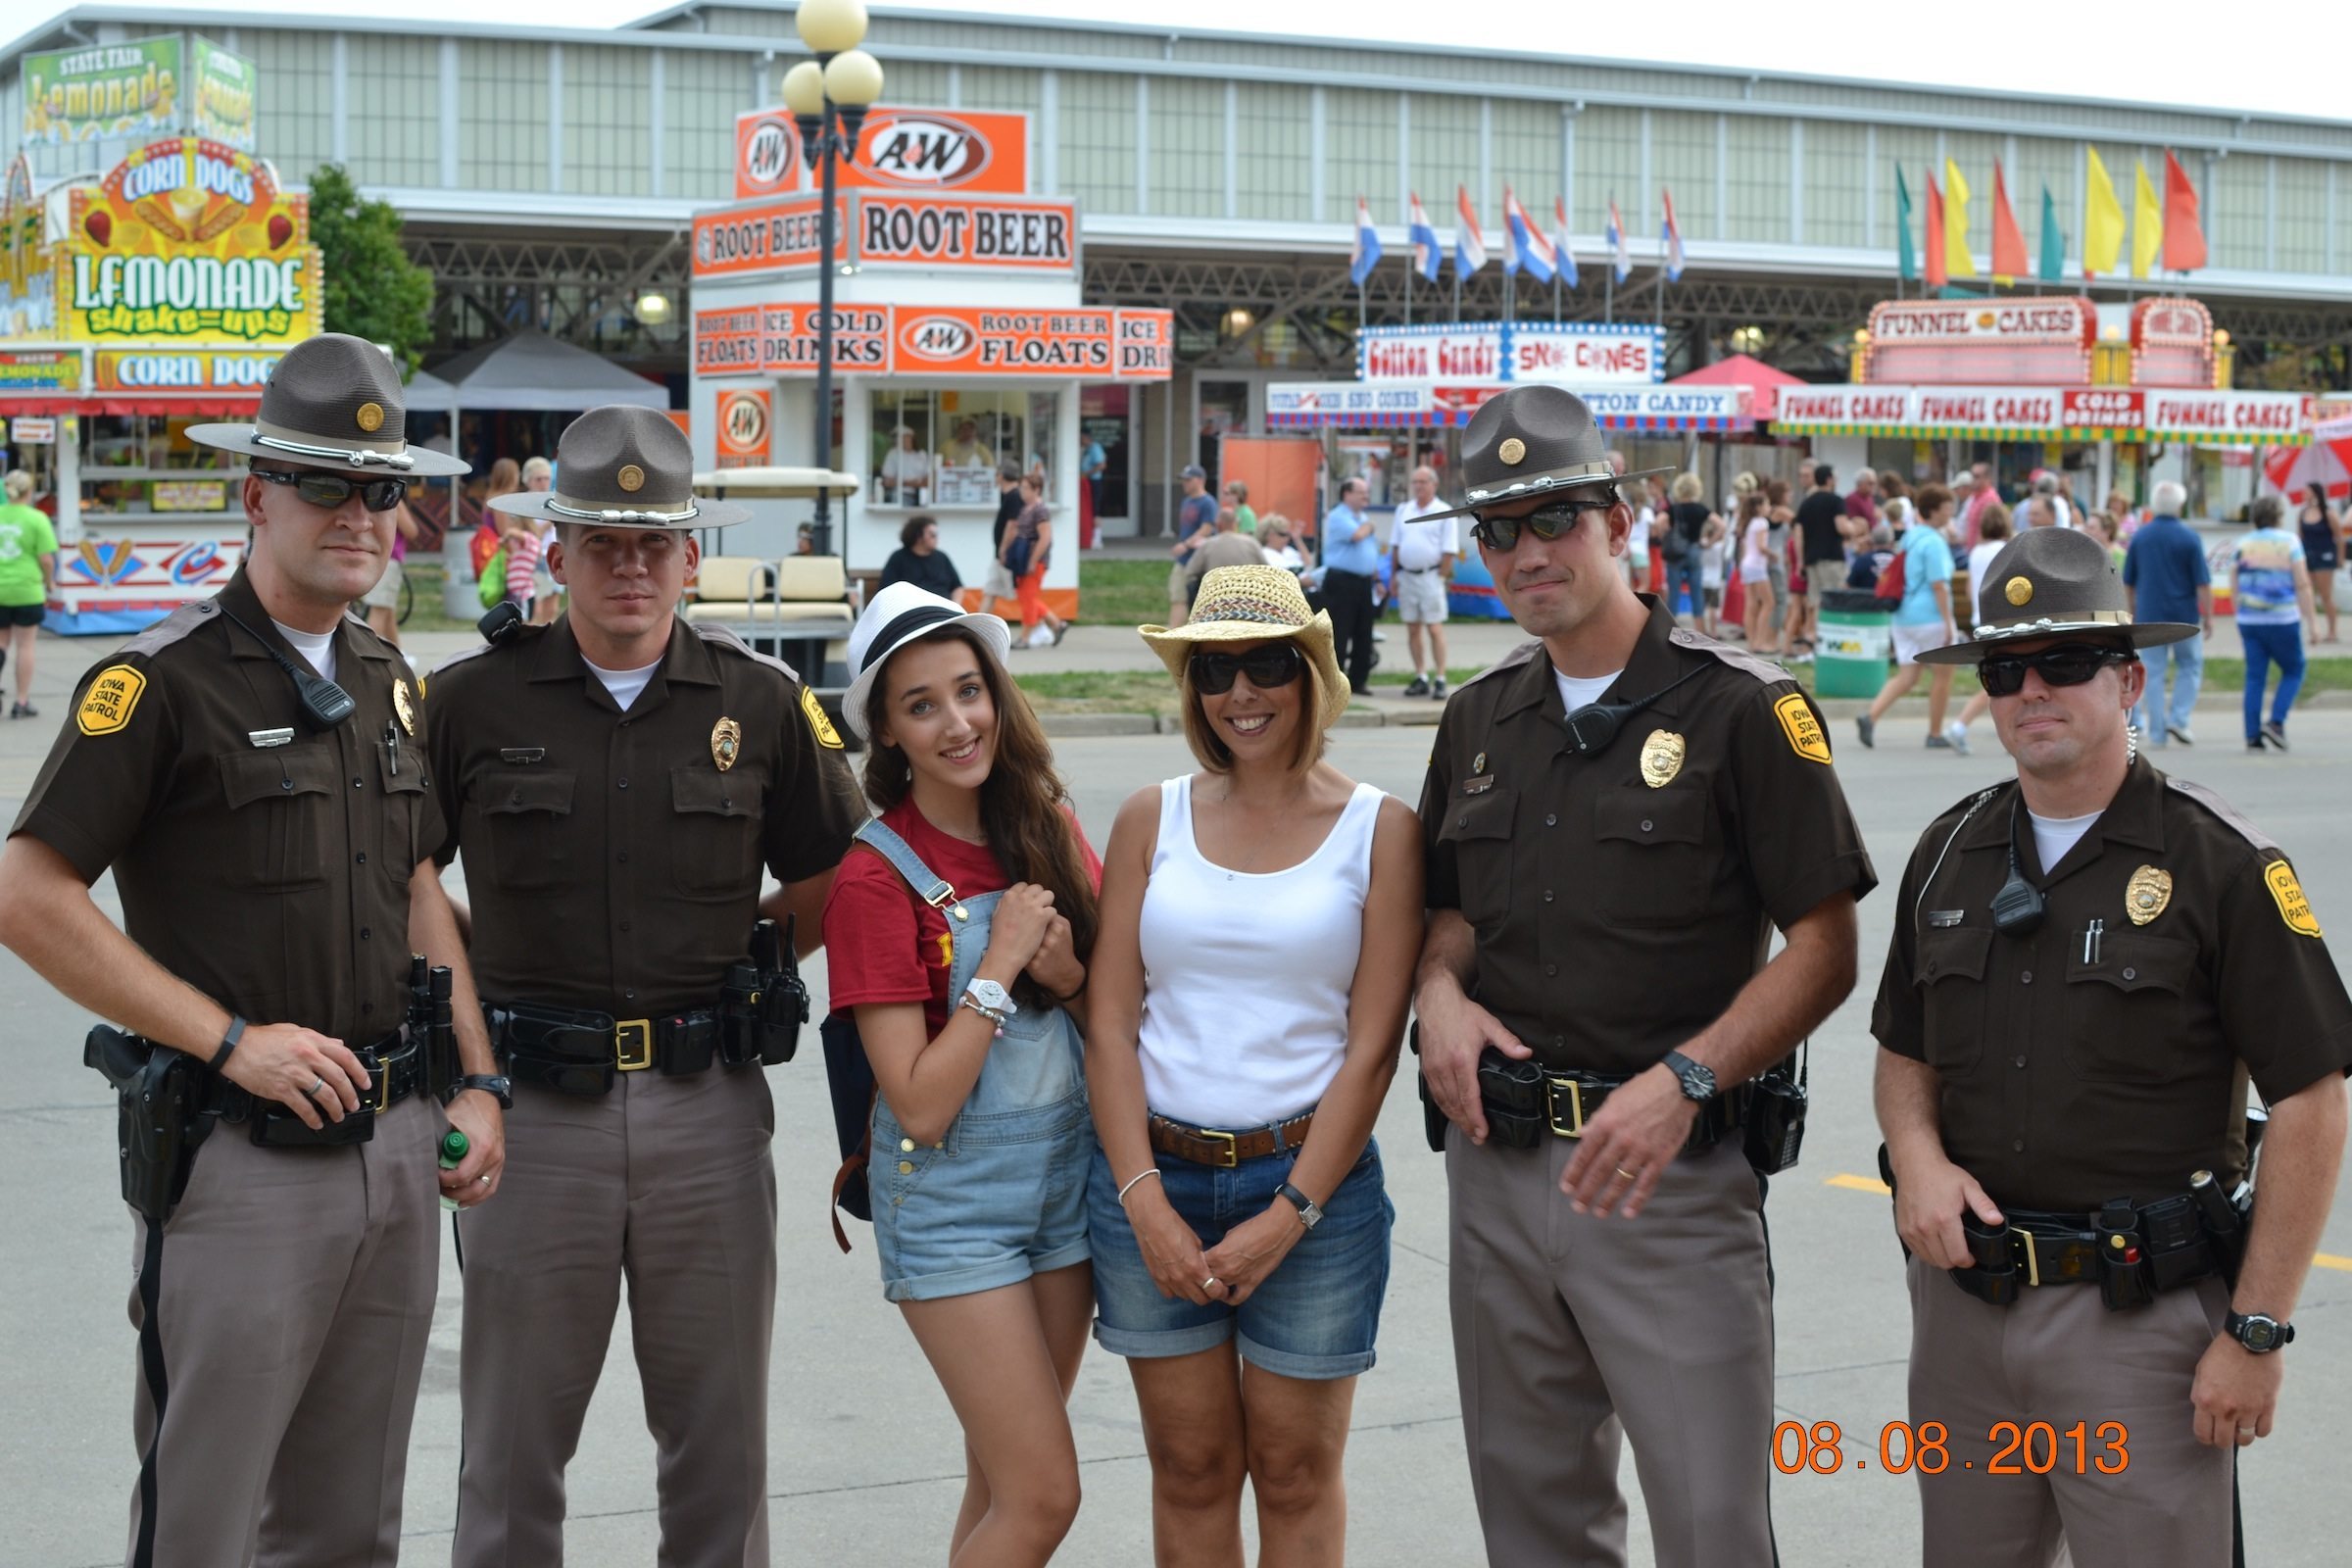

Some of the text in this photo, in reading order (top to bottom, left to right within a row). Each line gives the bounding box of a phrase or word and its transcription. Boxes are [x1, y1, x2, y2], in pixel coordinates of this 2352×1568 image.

[60, 47, 143, 75] STATE FAIR
[123, 153, 255, 205] CORN DOGS
[713, 223, 765, 260] ROOT
[867, 207, 1068, 259] ROOT BEER
[74, 256, 304, 310] LEMONADE
[982, 315, 1108, 333] ROOT BEER
[1122, 320, 1155, 339] ICE
[1881, 310, 2074, 335] FUNNEL CAKES
[698, 338, 758, 363] FLOATS
[983, 339, 1107, 365] FLOATS
[117, 355, 277, 387] CORN DOG
[1582, 394, 1726, 413] TTON CANDY
[1785, 396, 1843, 420] FUNNEL
[1851, 396, 1904, 422] CAKES
[1921, 397, 2053, 424] FUNNEL CAKES
[2074, 392, 2132, 410] COLD
[2064, 409, 2143, 427] DRINKS
[2156, 401, 2227, 428] FUNNEL
[2233, 403, 2293, 429] CAKES
[100, 678, 125, 693] IOWA
[93, 690, 122, 707] STATE
[83, 702, 119, 721] PATROL
